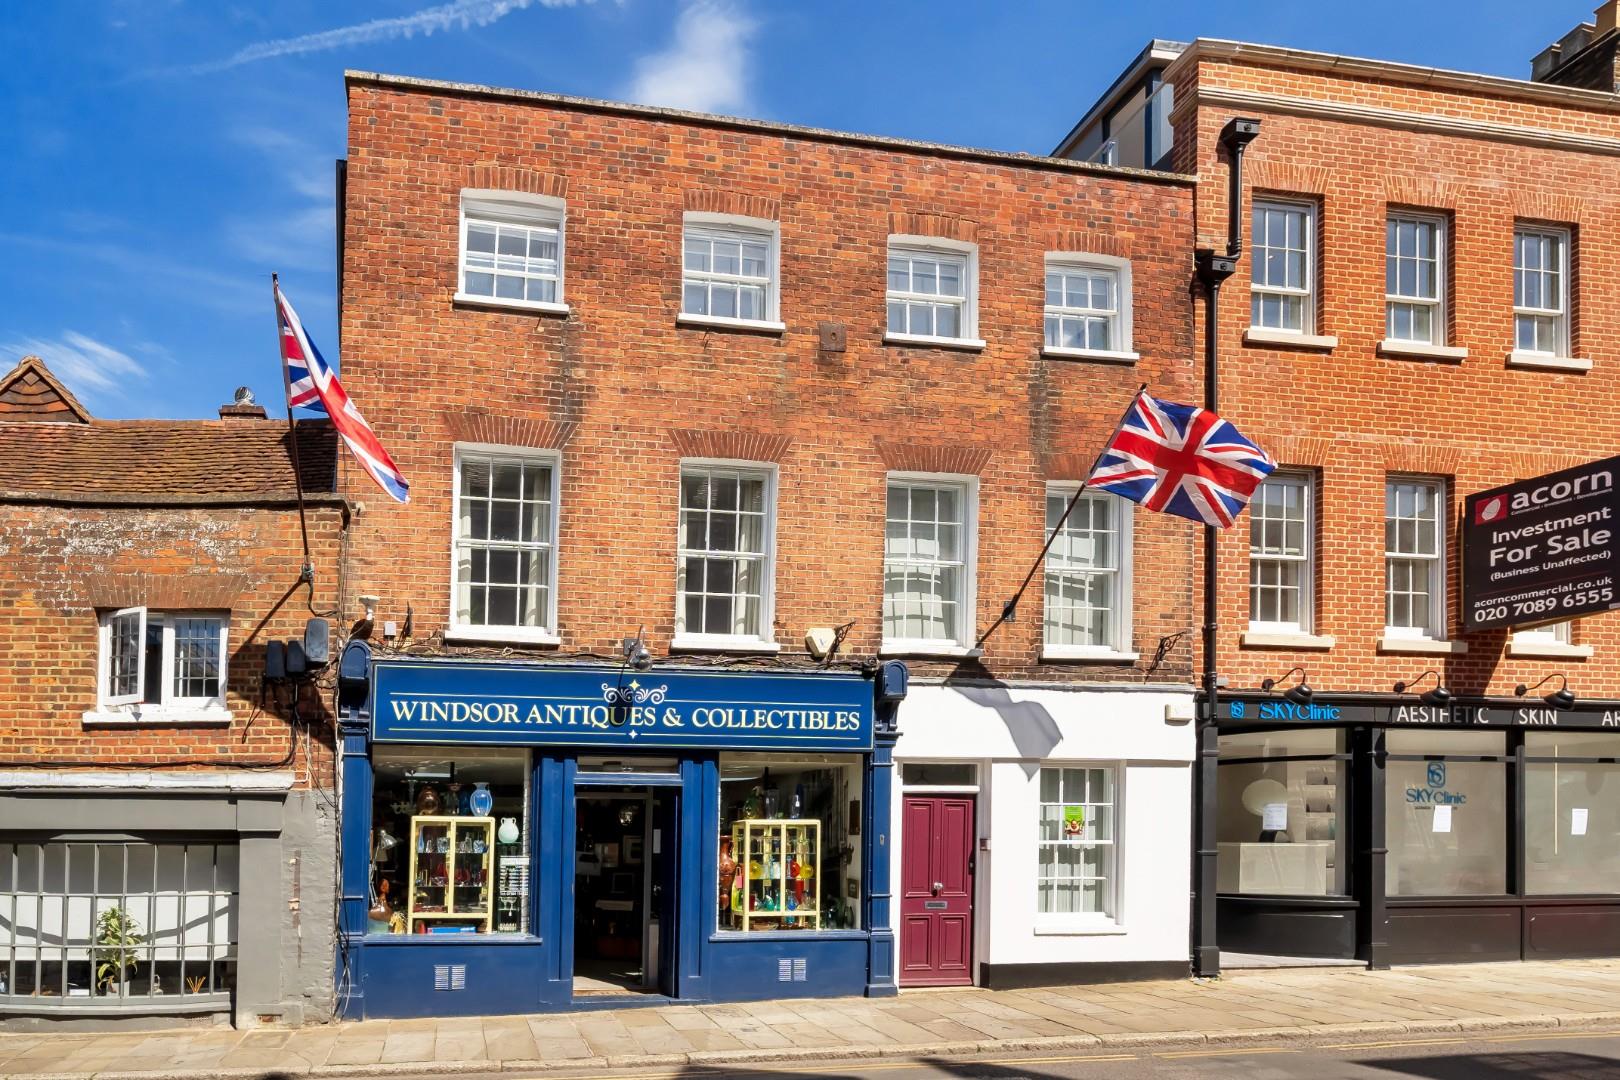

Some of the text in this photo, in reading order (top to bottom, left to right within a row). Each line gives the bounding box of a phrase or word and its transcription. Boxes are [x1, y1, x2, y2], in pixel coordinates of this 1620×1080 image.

[1512, 470, 1612, 510] acorn
[1492, 507, 1611, 544] Investment
[1490, 528, 1611, 567] For Sale
[1490, 550, 1612, 582] (Business Unaffected)
[1474, 576, 1612, 608] acorncommercial.co.uk
[1474, 588, 1613, 622] 020 7089 6555
[390, 700, 860, 731] WINDSOR ANTIQUES & COLLECTIBLES
[1396, 705, 1489, 724] AESTHETIC
[1518, 708, 1557, 725] SKIN
